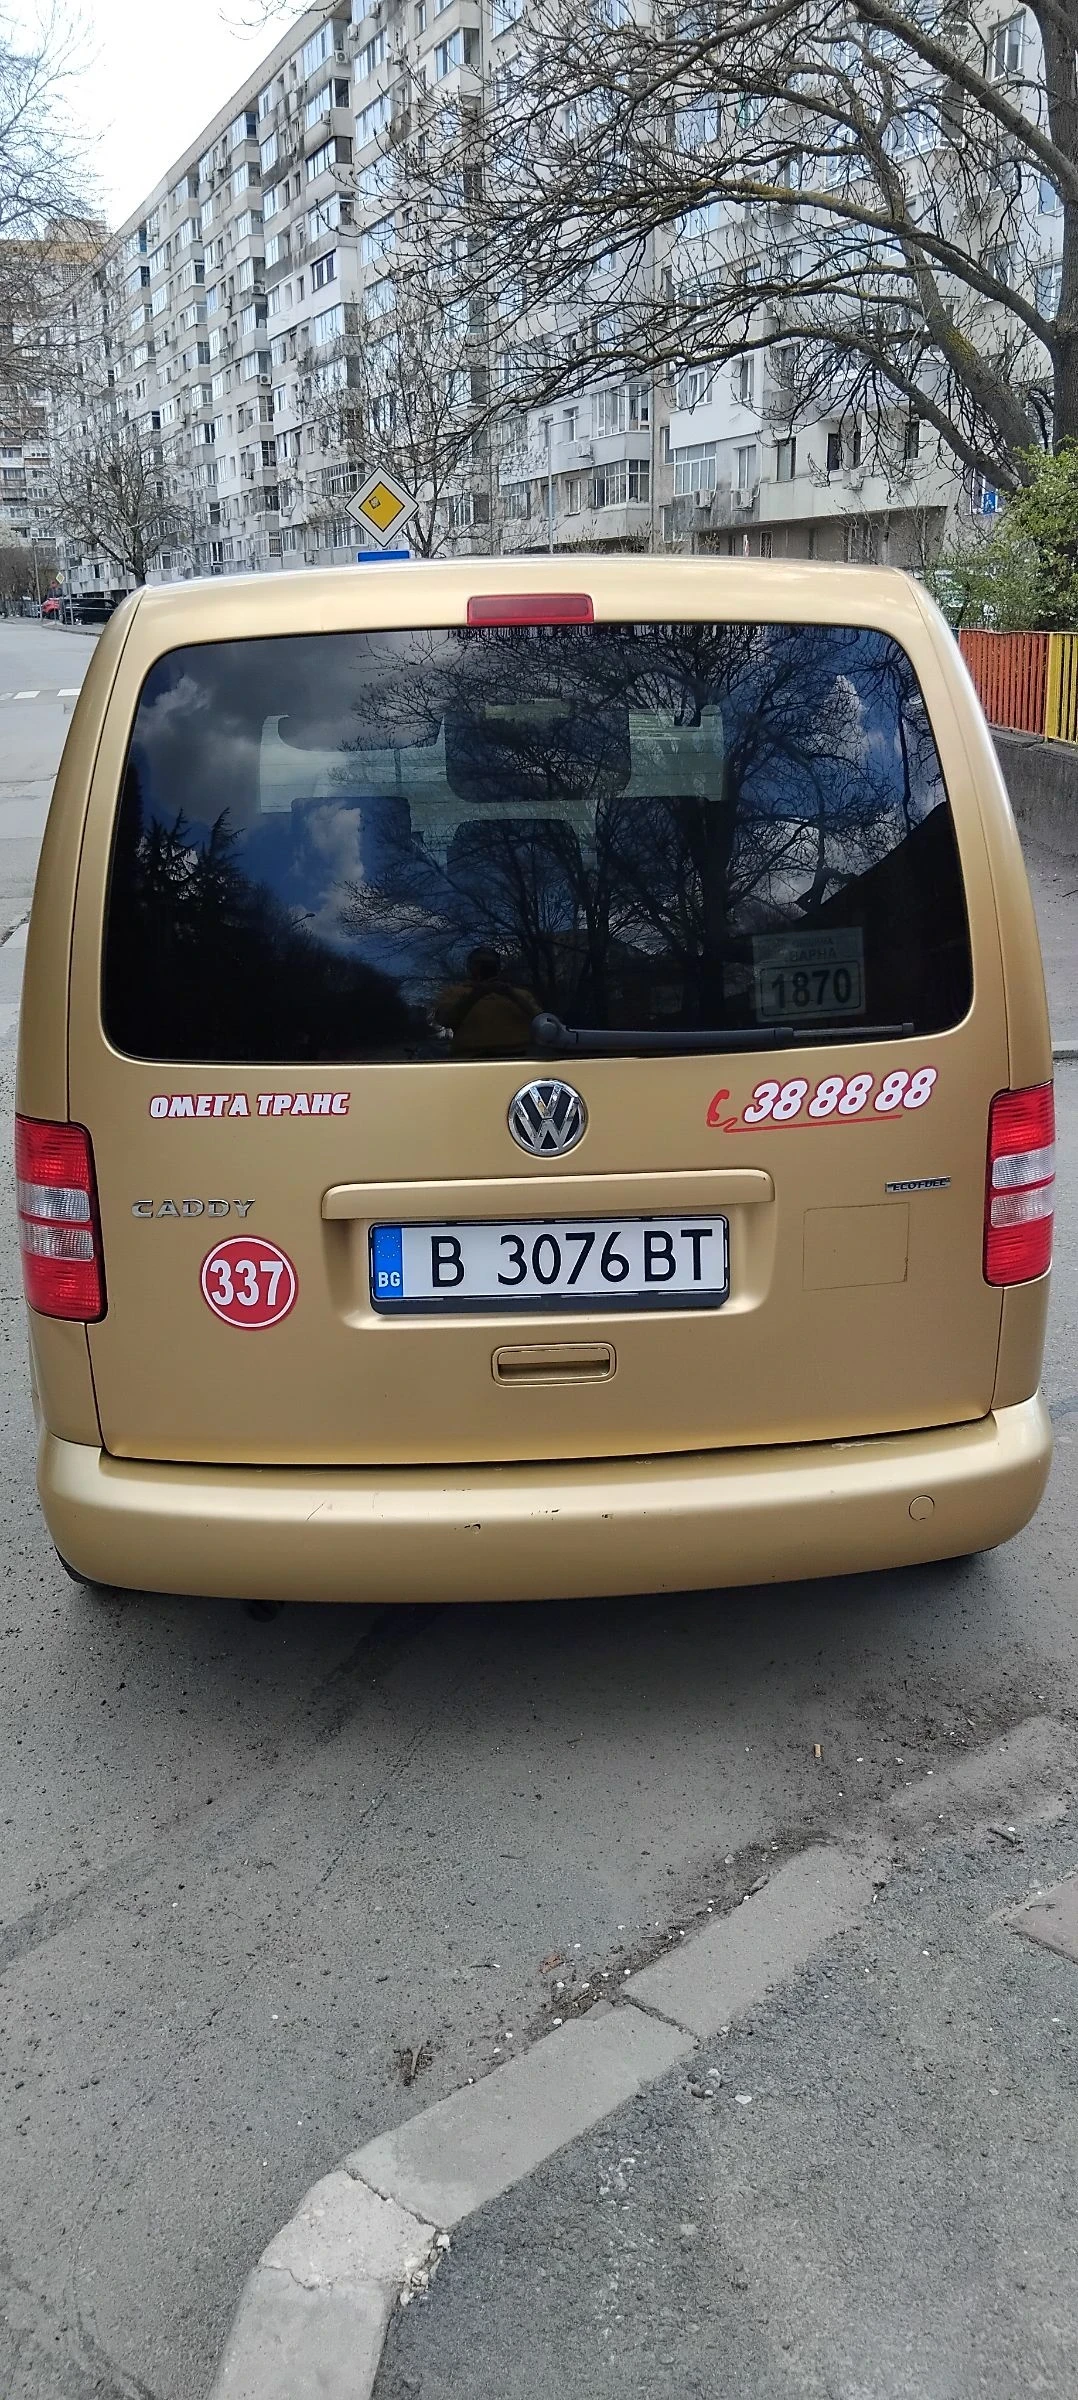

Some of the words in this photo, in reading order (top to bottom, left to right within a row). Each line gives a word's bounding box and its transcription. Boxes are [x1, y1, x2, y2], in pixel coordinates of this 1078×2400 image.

[772, 967, 852, 1009] 1870
[149, 1094, 249, 1118] ОМЕГА
[257, 1092, 350, 1116] ТРАНС
[743, 1080, 809, 1124] 38
[808, 1074, 874, 1119] 88
[873, 1067, 938, 1112] 88
[130, 1198, 255, 1218] CADDY
[430, 1235, 465, 1288] B
[497, 1231, 630, 1285] 3076
[643, 1228, 713, 1283] BT
[210, 1259, 284, 1306] 337
[378, 1271, 400, 1288] BG
